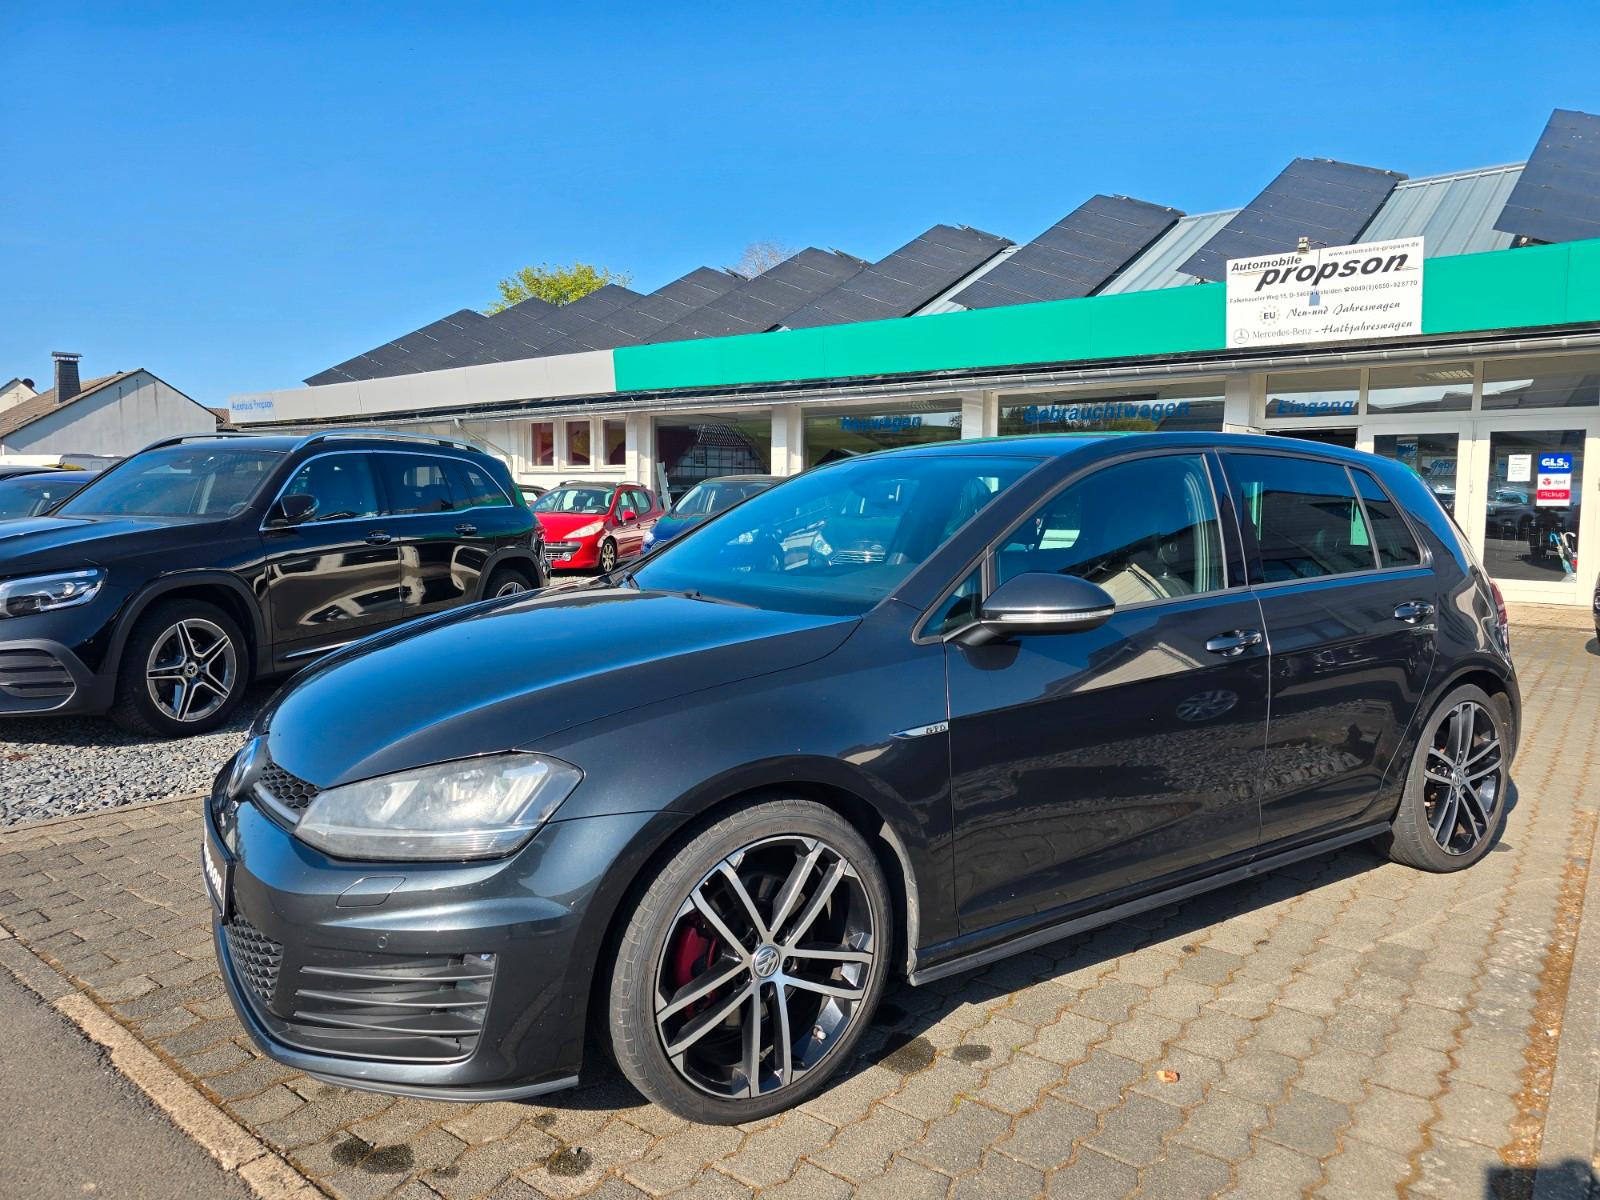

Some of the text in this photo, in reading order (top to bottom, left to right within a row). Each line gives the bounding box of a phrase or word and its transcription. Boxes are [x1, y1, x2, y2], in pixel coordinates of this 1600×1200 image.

[1231, 255, 1303, 273] Automobile
[1253, 253, 1409, 293] propson
[1263, 311, 1276, 320] EU
[1333, 301, 1401, 316] Jahreswagen
[1252, 327, 1312, 340] Mercedes-Benz
[1023, 401, 1192, 425] Gebrauchtwagen
[1277, 399, 1354, 416] Eingang
[1541, 457, 1564, 467] GLS
